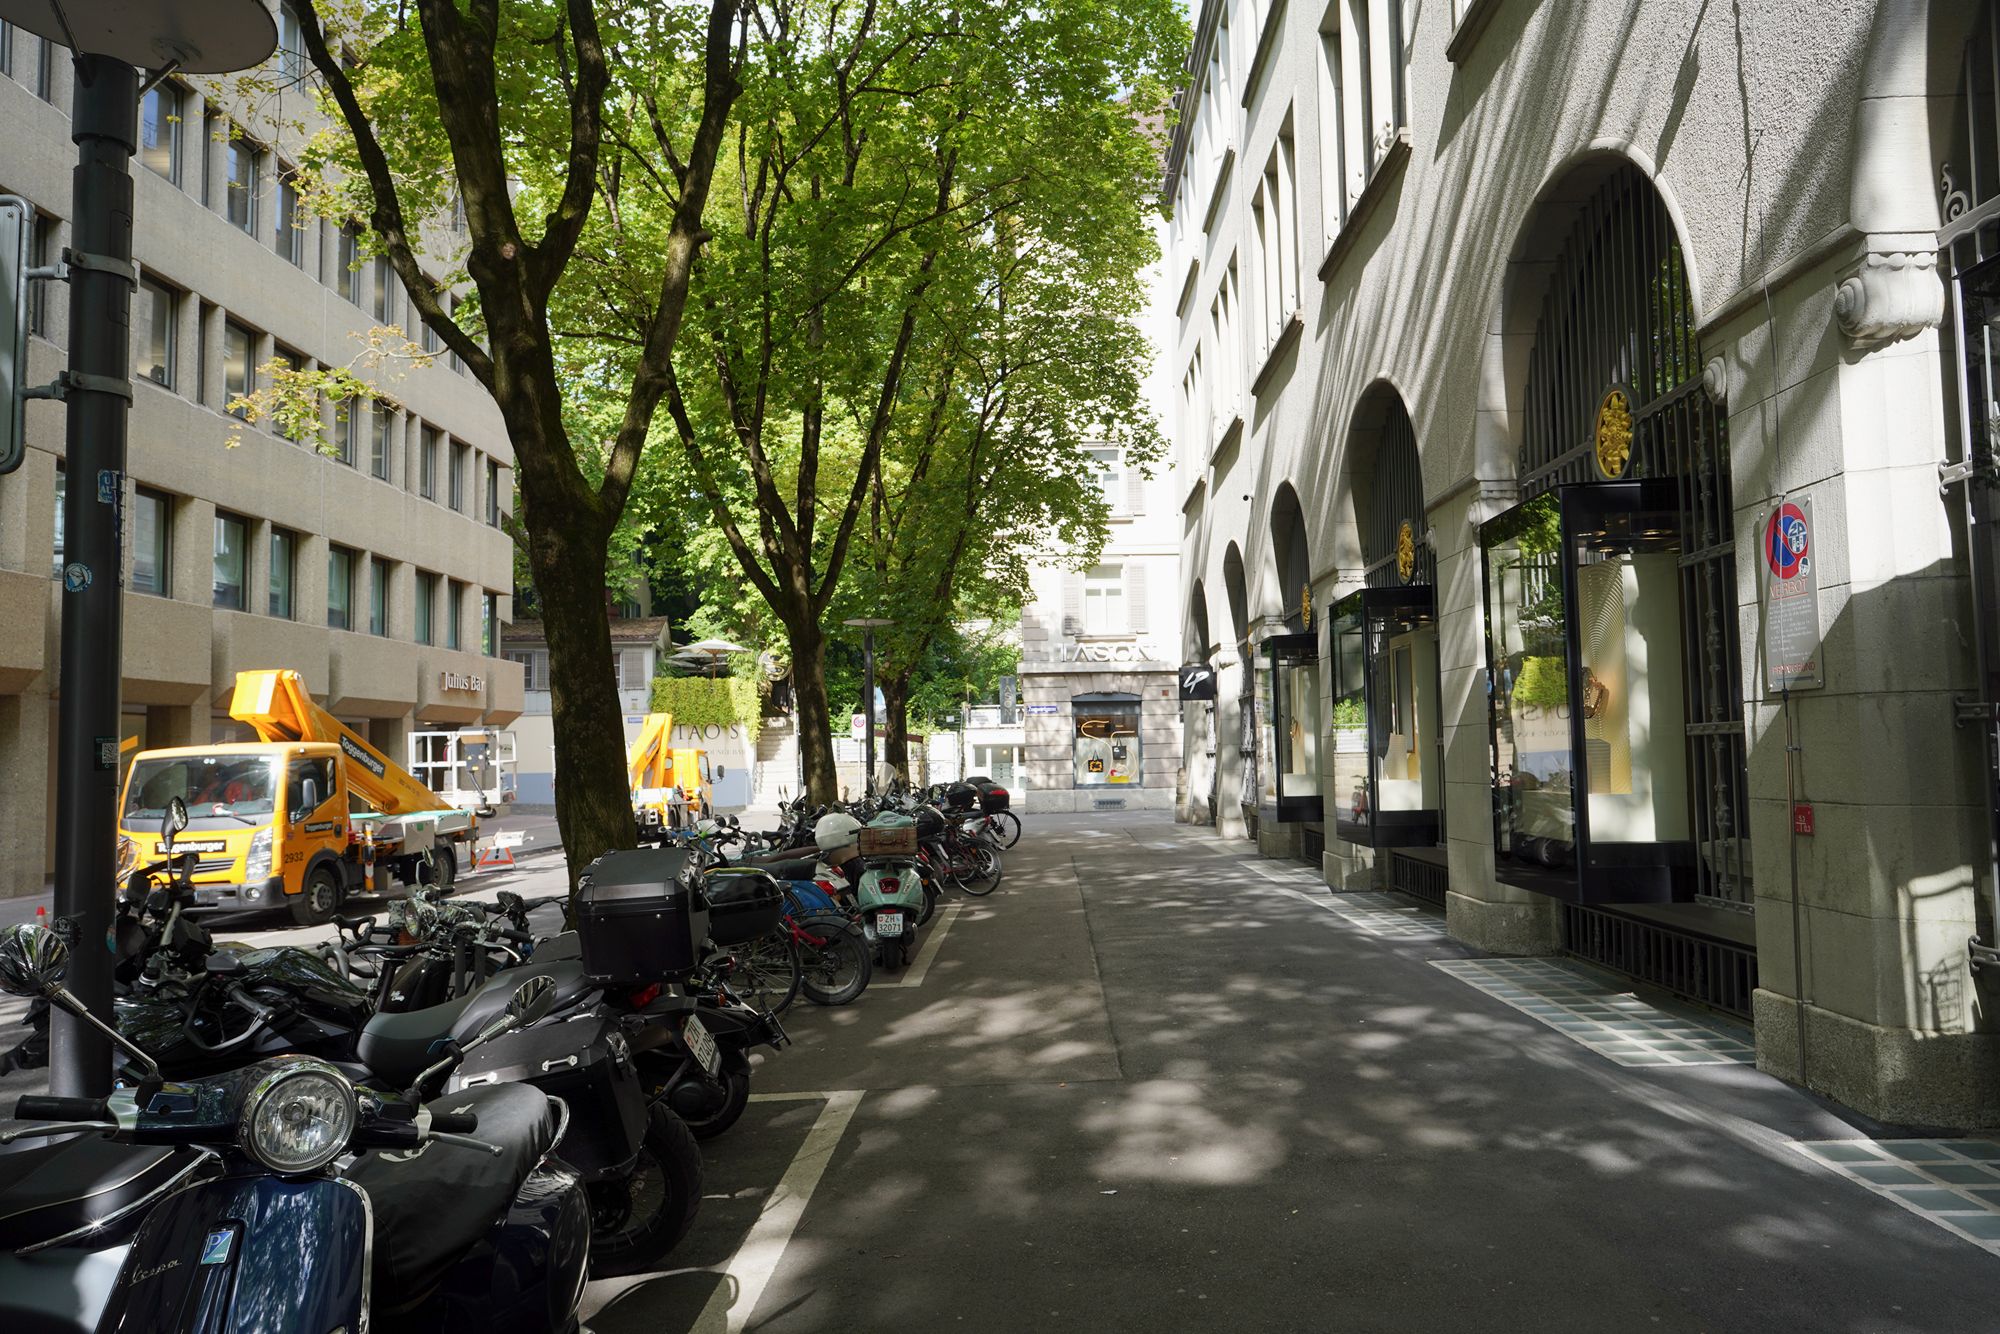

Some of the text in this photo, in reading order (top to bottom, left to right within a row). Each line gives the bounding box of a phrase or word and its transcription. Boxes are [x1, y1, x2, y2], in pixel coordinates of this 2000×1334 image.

[1769, 577, 1808, 598] VERBOT
[444, 672, 485, 691] Julius Bär
[677, 723, 739, 740] TAOS
[341, 736, 384, 774] Toggenburger
[156, 841, 225, 854] Togenburger
[285, 851, 303, 863] 2932
[879, 924, 902, 932] 32071
[885, 915, 895, 923] ZH
[687, 1021, 701, 1044] ZH
[128, 1259, 182, 1288] Vespa
